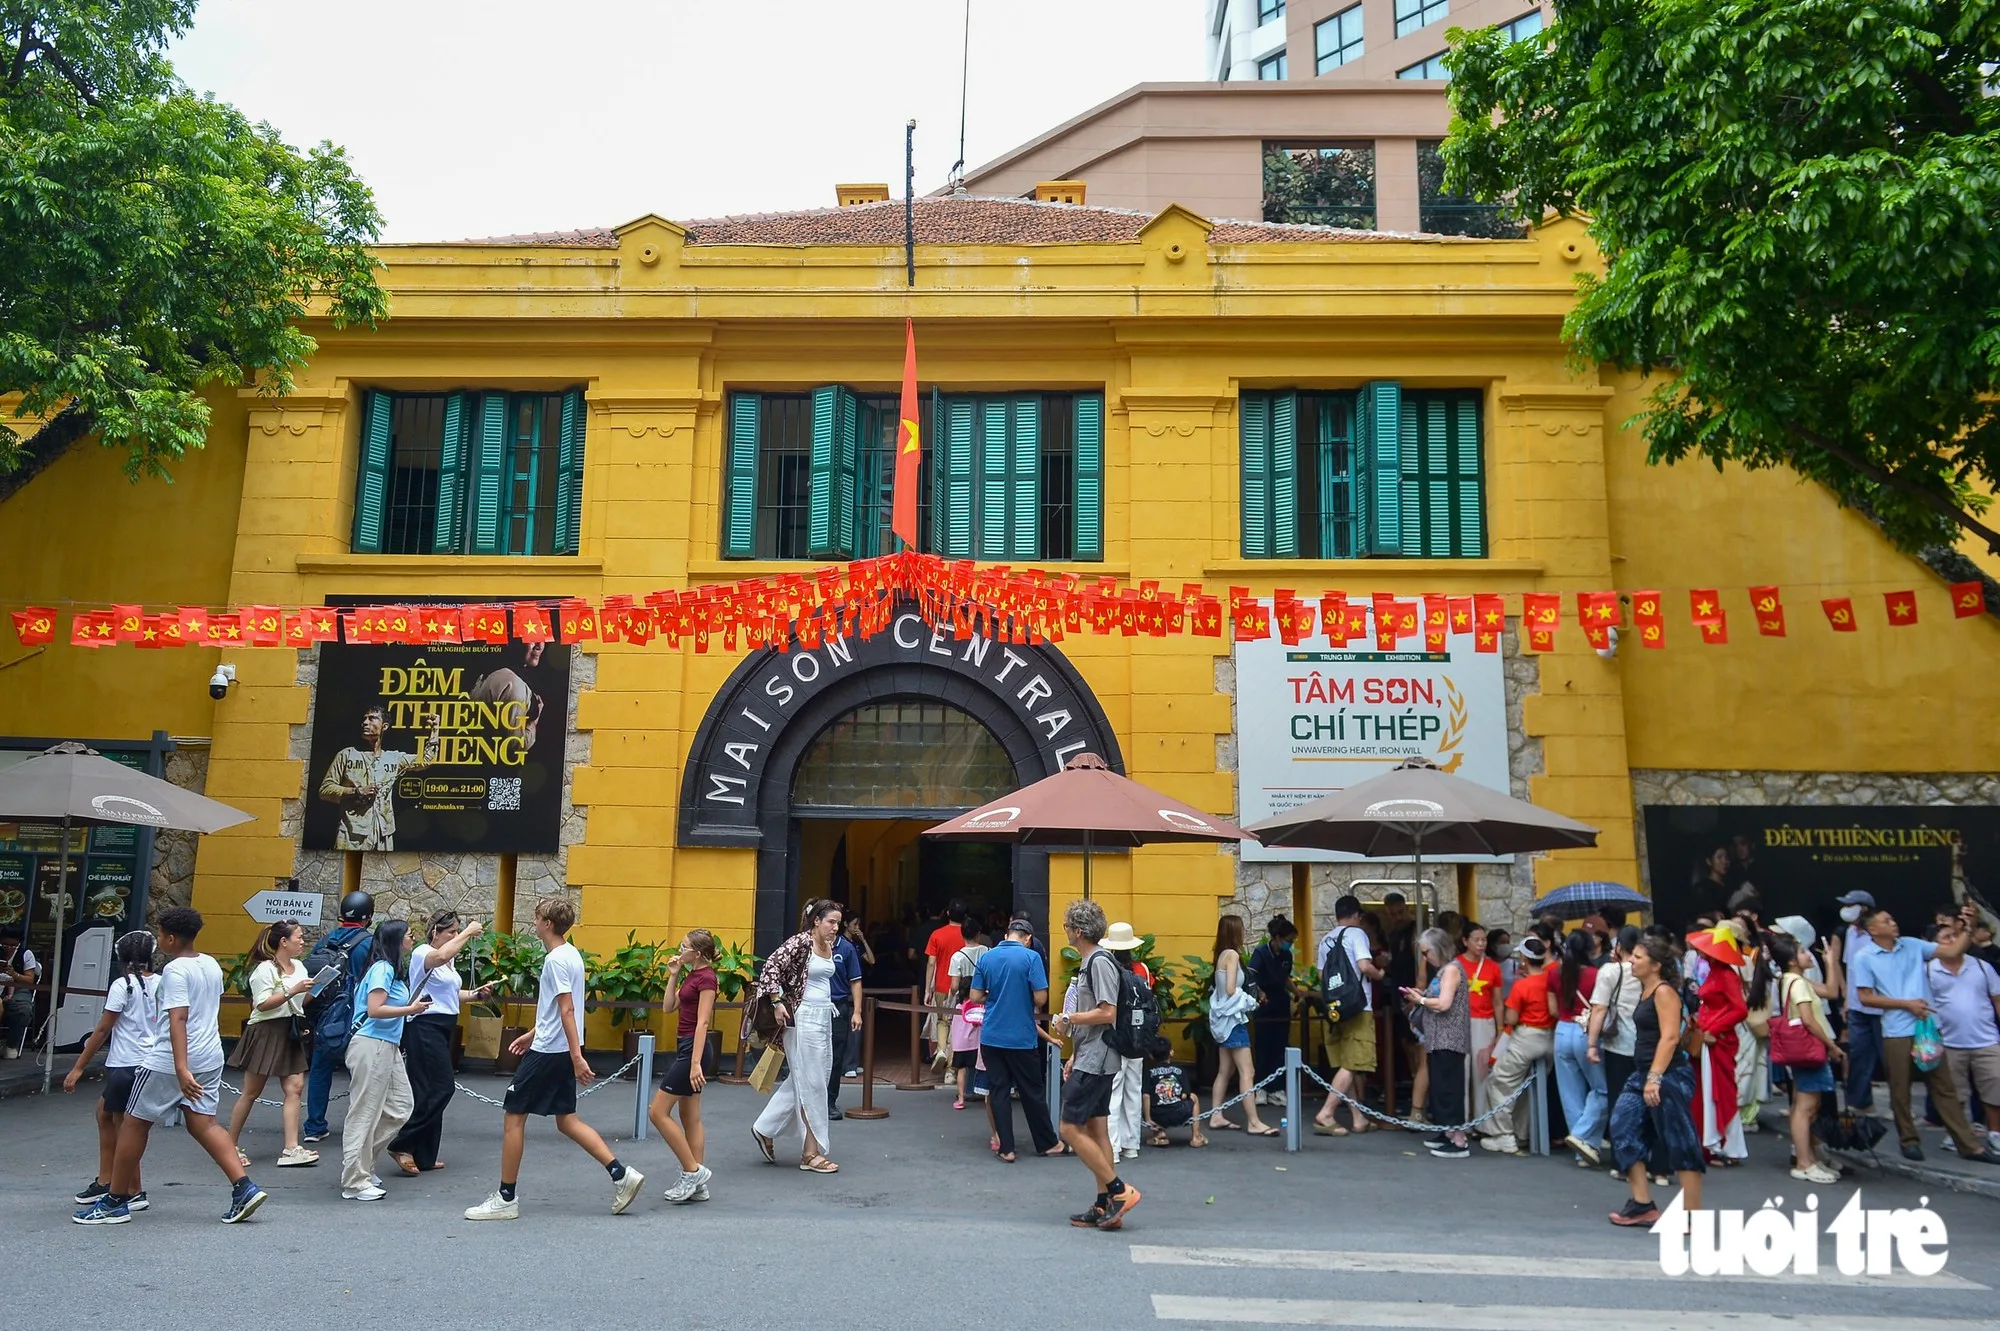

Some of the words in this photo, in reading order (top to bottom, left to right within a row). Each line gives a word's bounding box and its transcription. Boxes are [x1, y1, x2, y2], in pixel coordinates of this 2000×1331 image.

[378, 658, 465, 696] ĐÊM
[1287, 671, 1354, 704] TÂM
[387, 692, 530, 730] THIÊNG
[706, 632, 854, 805] MAISON
[893, 613, 1087, 773] CENTRAL
[1290, 708, 1346, 741] CHÍ
[1352, 708, 1441, 741] THÉP
[413, 726, 528, 766] LIÊNG
[1291, 746, 1348, 754] UNWAVERING
[1349, 746, 1378, 755] HEART,
[1379, 746, 1400, 754] IRON
[1401, 746, 1422, 754] WILL
[426, 784, 448, 793] 19:00
[460, 784, 484, 793] 21:00
[1764, 823, 1813, 847] ĐÊM
[1814, 823, 1896, 847] THIÊNG
[1897, 823, 1961, 847] LIÊNG
[265, 907, 288, 916] Ticket
[289, 909, 312, 917] Office
[266, 898, 282, 906] NƠI
[283, 898, 301, 907] BÁN
[303, 899, 314, 908] VÉ
